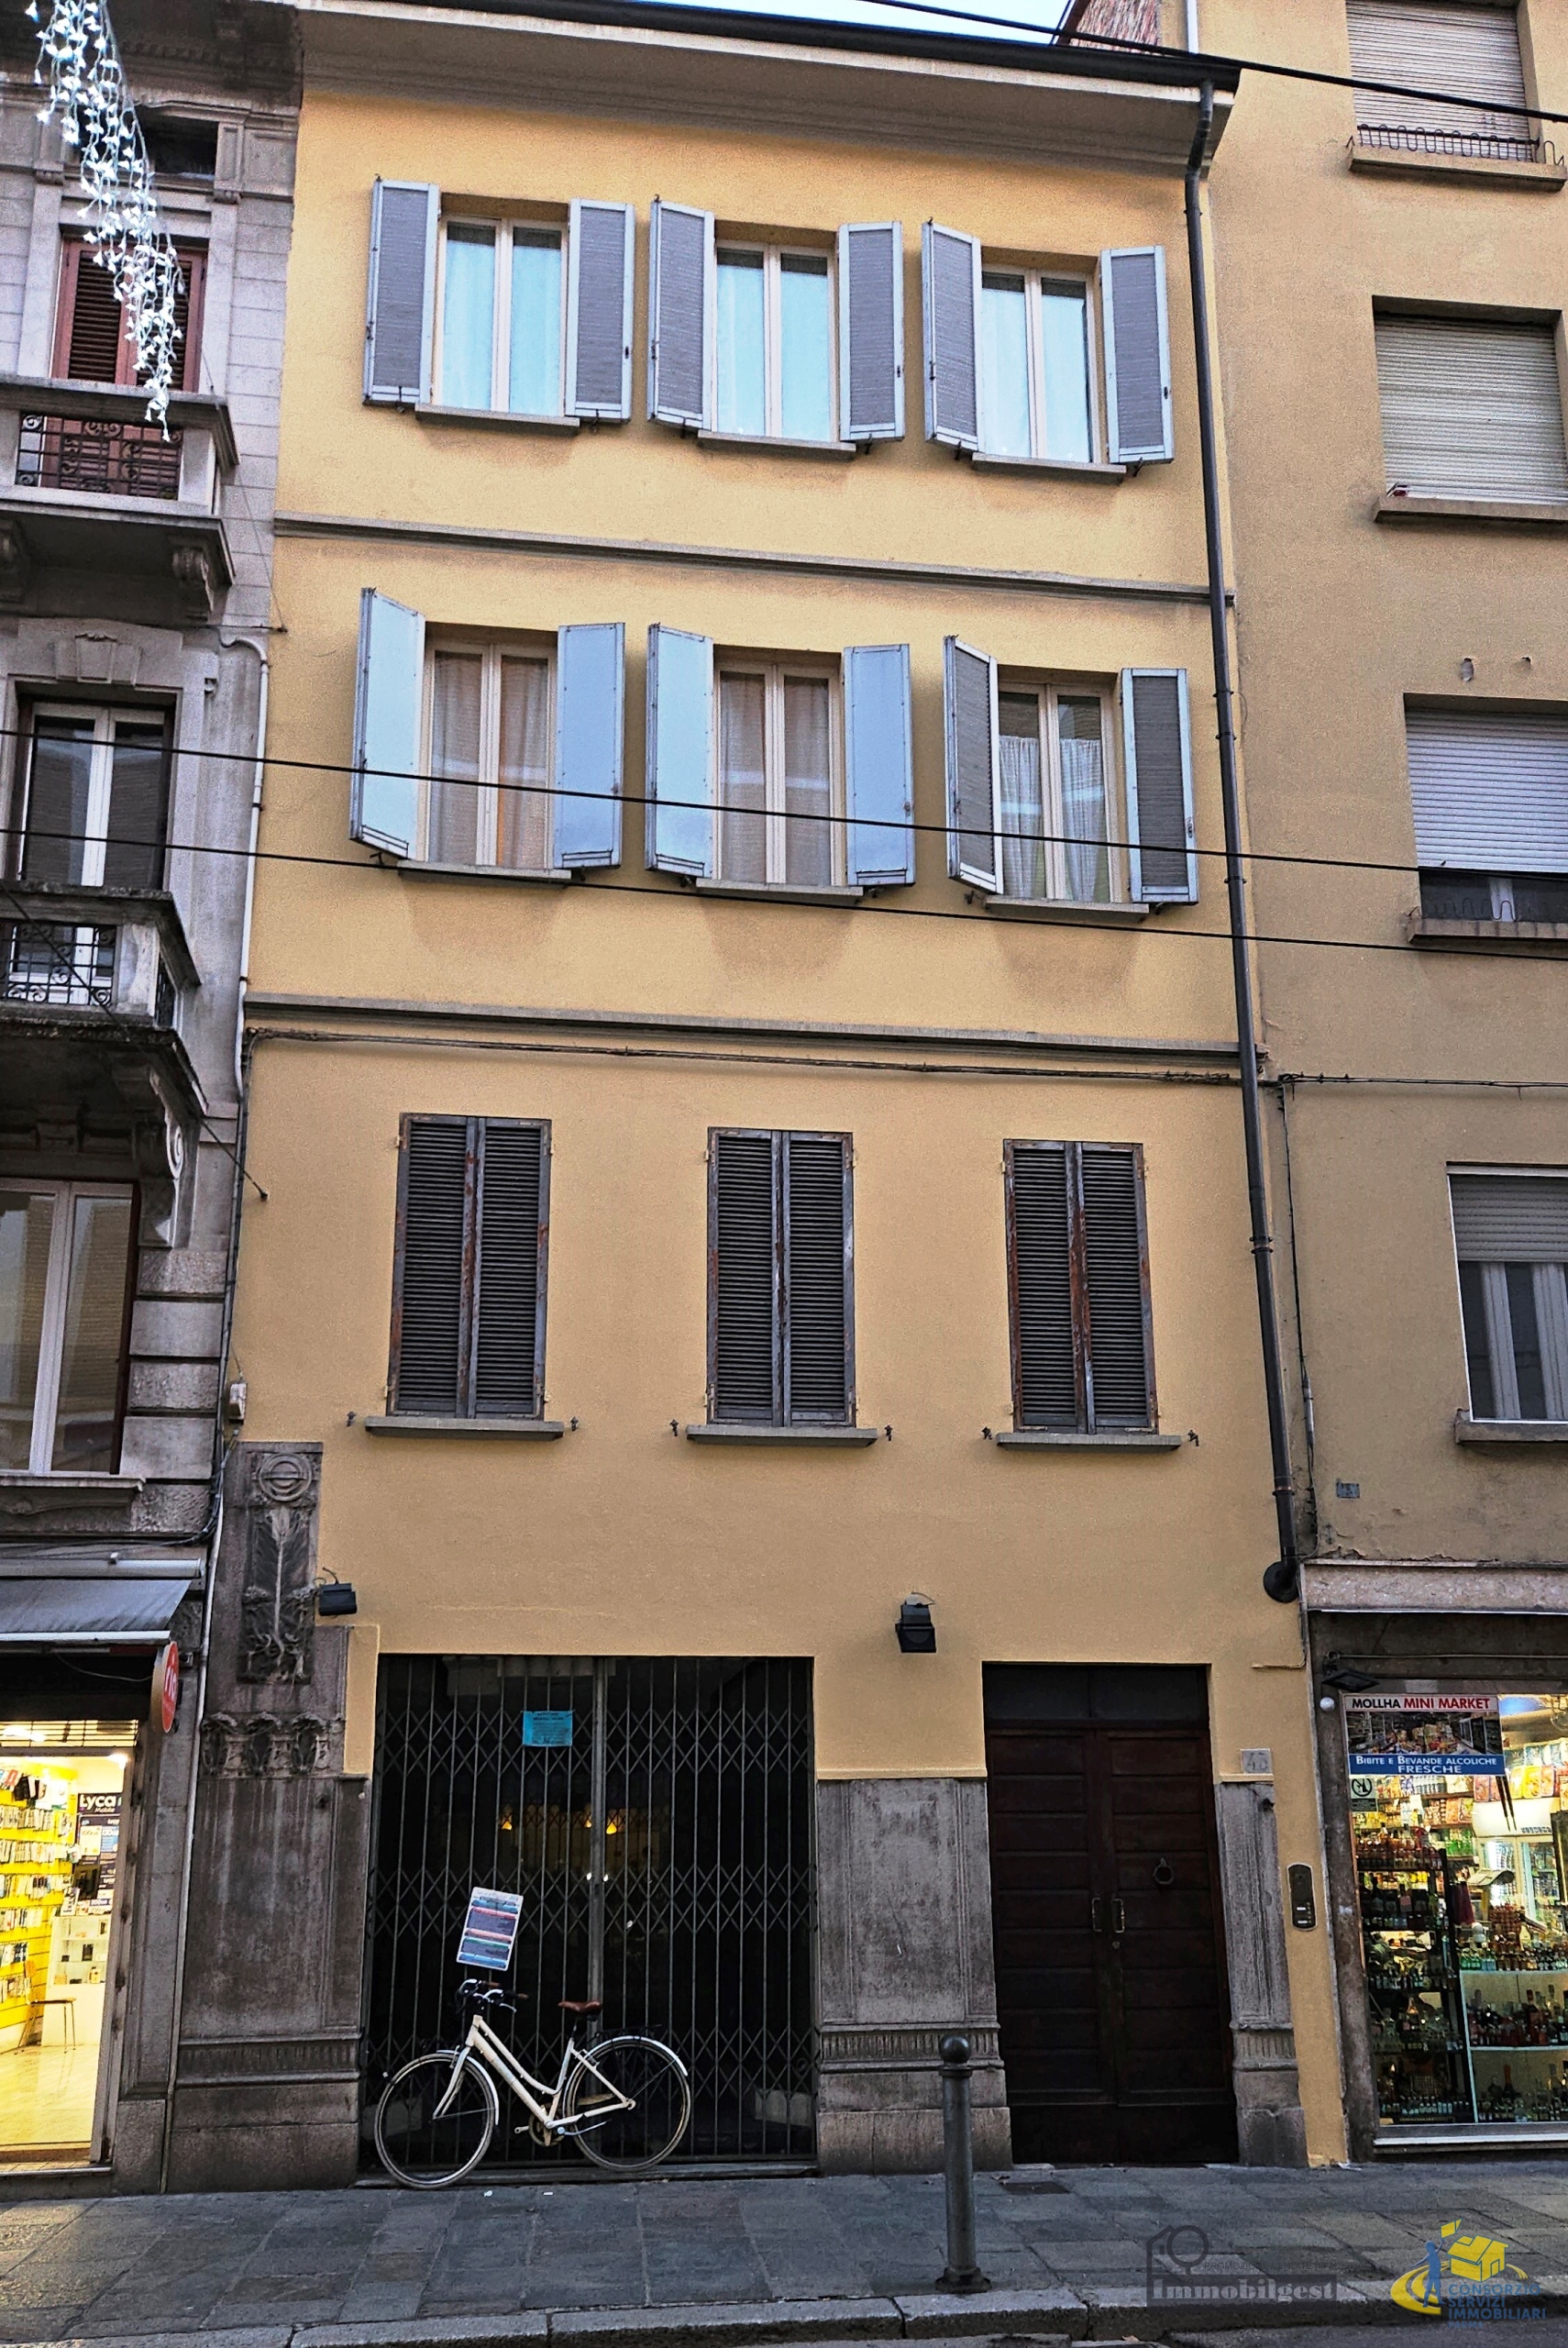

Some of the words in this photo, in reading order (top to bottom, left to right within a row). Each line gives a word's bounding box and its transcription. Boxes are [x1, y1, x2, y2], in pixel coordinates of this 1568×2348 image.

[1352, 1698, 1401, 1709] MOLLHA
[1404, 1698, 1434, 1709] MINI
[1438, 1698, 1490, 1709] MARKET
[1356, 1755, 1385, 1765] BIBITE
[1397, 1755, 1442, 1765] BEVANDE
[1446, 1756, 1496, 1765] ALCOLICHE
[1397, 1766, 1463, 1774] FRESCHE
[79, 1794, 116, 1810] Lyca
